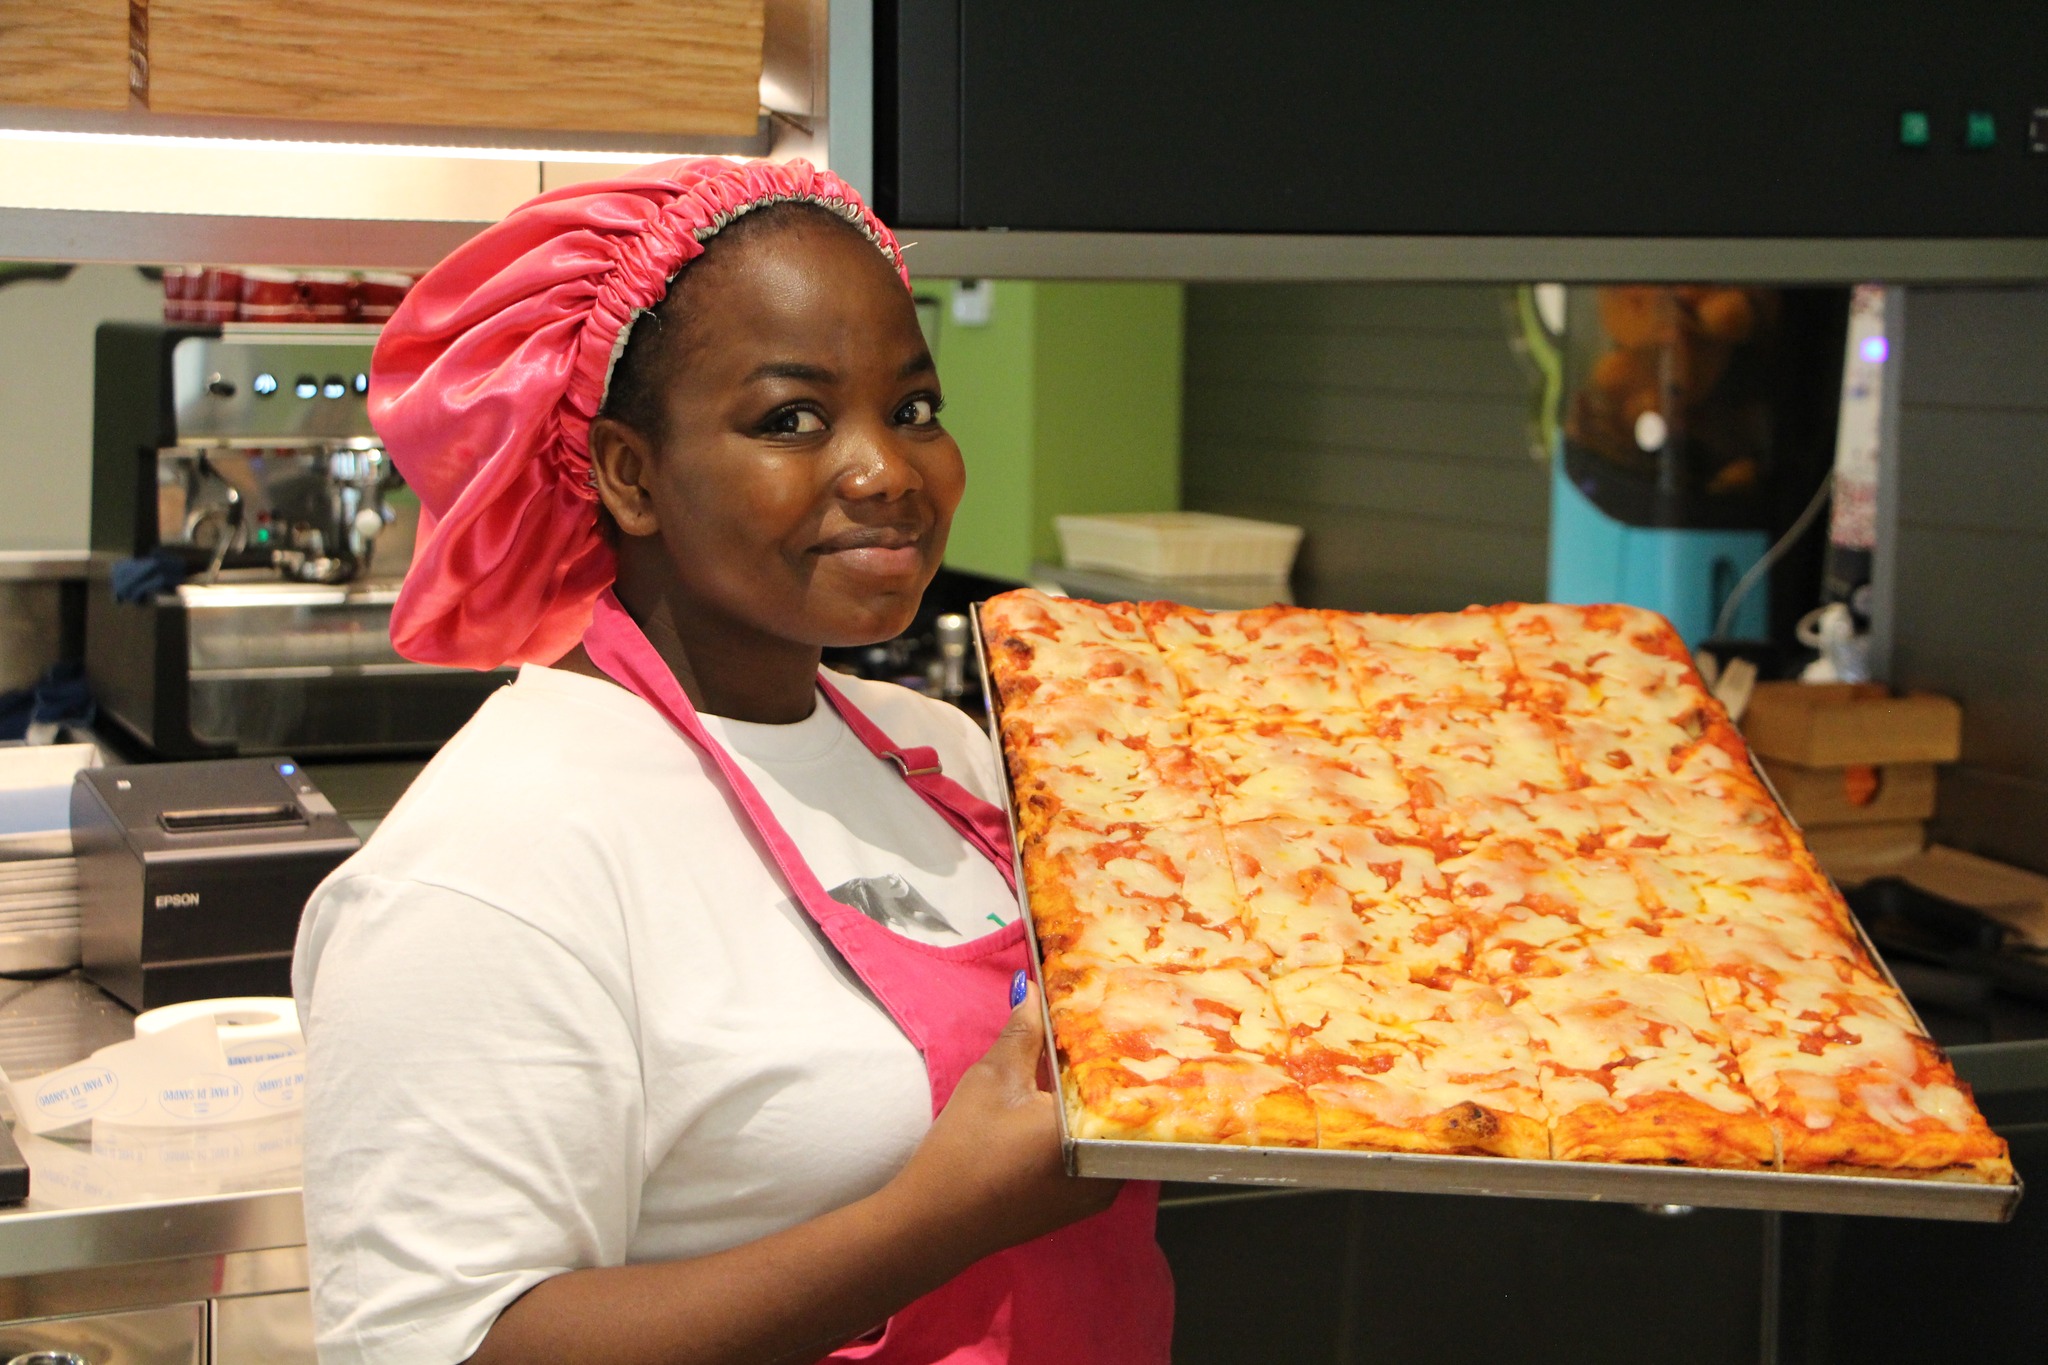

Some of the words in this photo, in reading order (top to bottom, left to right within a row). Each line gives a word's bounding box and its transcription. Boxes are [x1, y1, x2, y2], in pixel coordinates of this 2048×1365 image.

[155, 893, 200, 908] EPSON
[104, 1072, 112, 1084] IL
[70, 1085, 80, 1096] DI
[83, 1077, 102, 1092] PANE
[39, 1089, 69, 1106] SANDRO
[163, 1089, 194, 1101] SANDRO
[197, 1088, 207, 1100] DI
[210, 1087, 229, 1098] PANE
